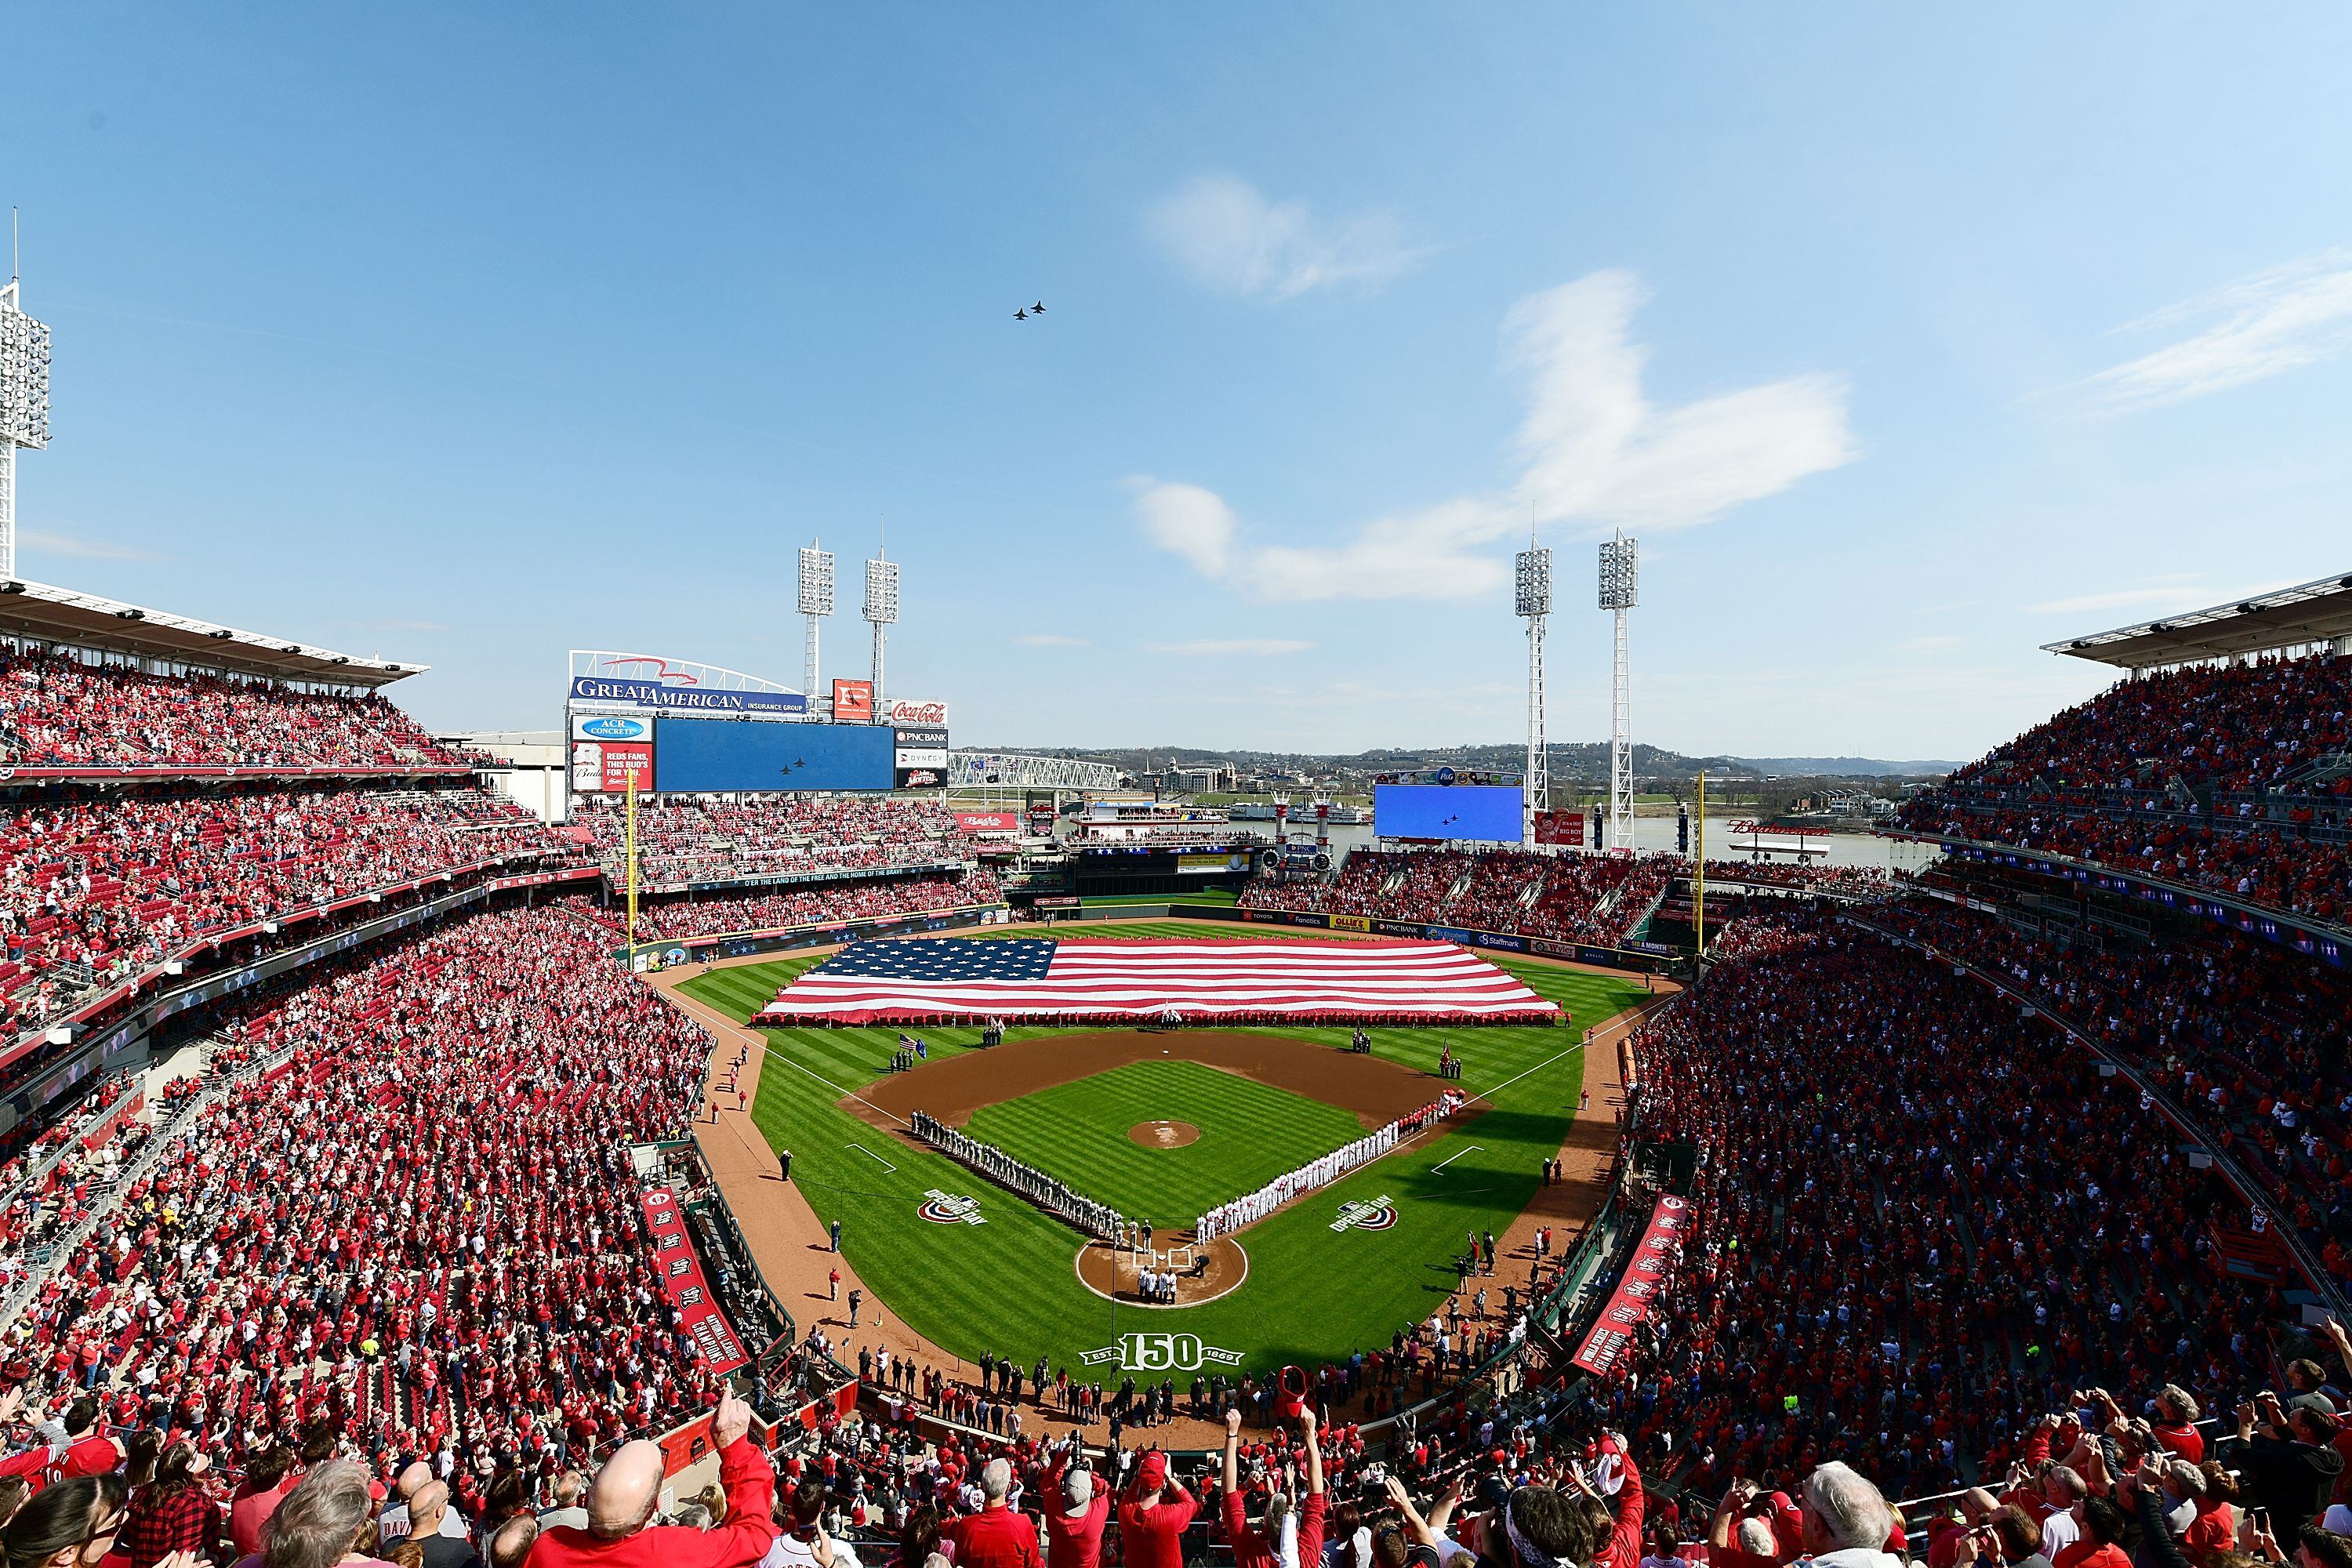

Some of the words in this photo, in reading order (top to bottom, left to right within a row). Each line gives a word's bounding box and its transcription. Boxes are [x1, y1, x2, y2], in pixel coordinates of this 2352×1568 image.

[747, 702, 782, 711] INSURANCE
[891, 702, 946, 724] Coca-Cola
[628, 753, 649, 761] FANS,
[964, 816, 1002, 826] Reds
[1295, 916, 1321, 924] Fanatics
[1490, 937, 1519, 948] Staffmark
[1548, 944, 1574, 954] Wyler
[1646, 942, 1667, 951] MONTH
[924, 1189, 970, 1215] OPENING
[959, 1212, 988, 1225] DAY
[1329, 1205, 1377, 1232] OPENING
[1370, 1194, 1394, 1209] DAY
[1639, 1255, 1661, 1273] 1975
[682, 1286, 701, 1306] 1972
[1613, 1305, 1639, 1325] 1919
[691, 1321, 725, 1365] CHAMPIONS
[705, 1314, 722, 1341] NATIONAL
[719, 1336, 740, 1361] LEAGUE
[1581, 1342, 1598, 1363] WORLD
[1596, 1327, 1610, 1346] SERIES
[1092, 1351, 1117, 1361] EST.
[1118, 1333, 1203, 1371] 150
[1206, 1350, 1234, 1361] 1869
[1593, 1330, 1626, 1372] CHAMPIONS
